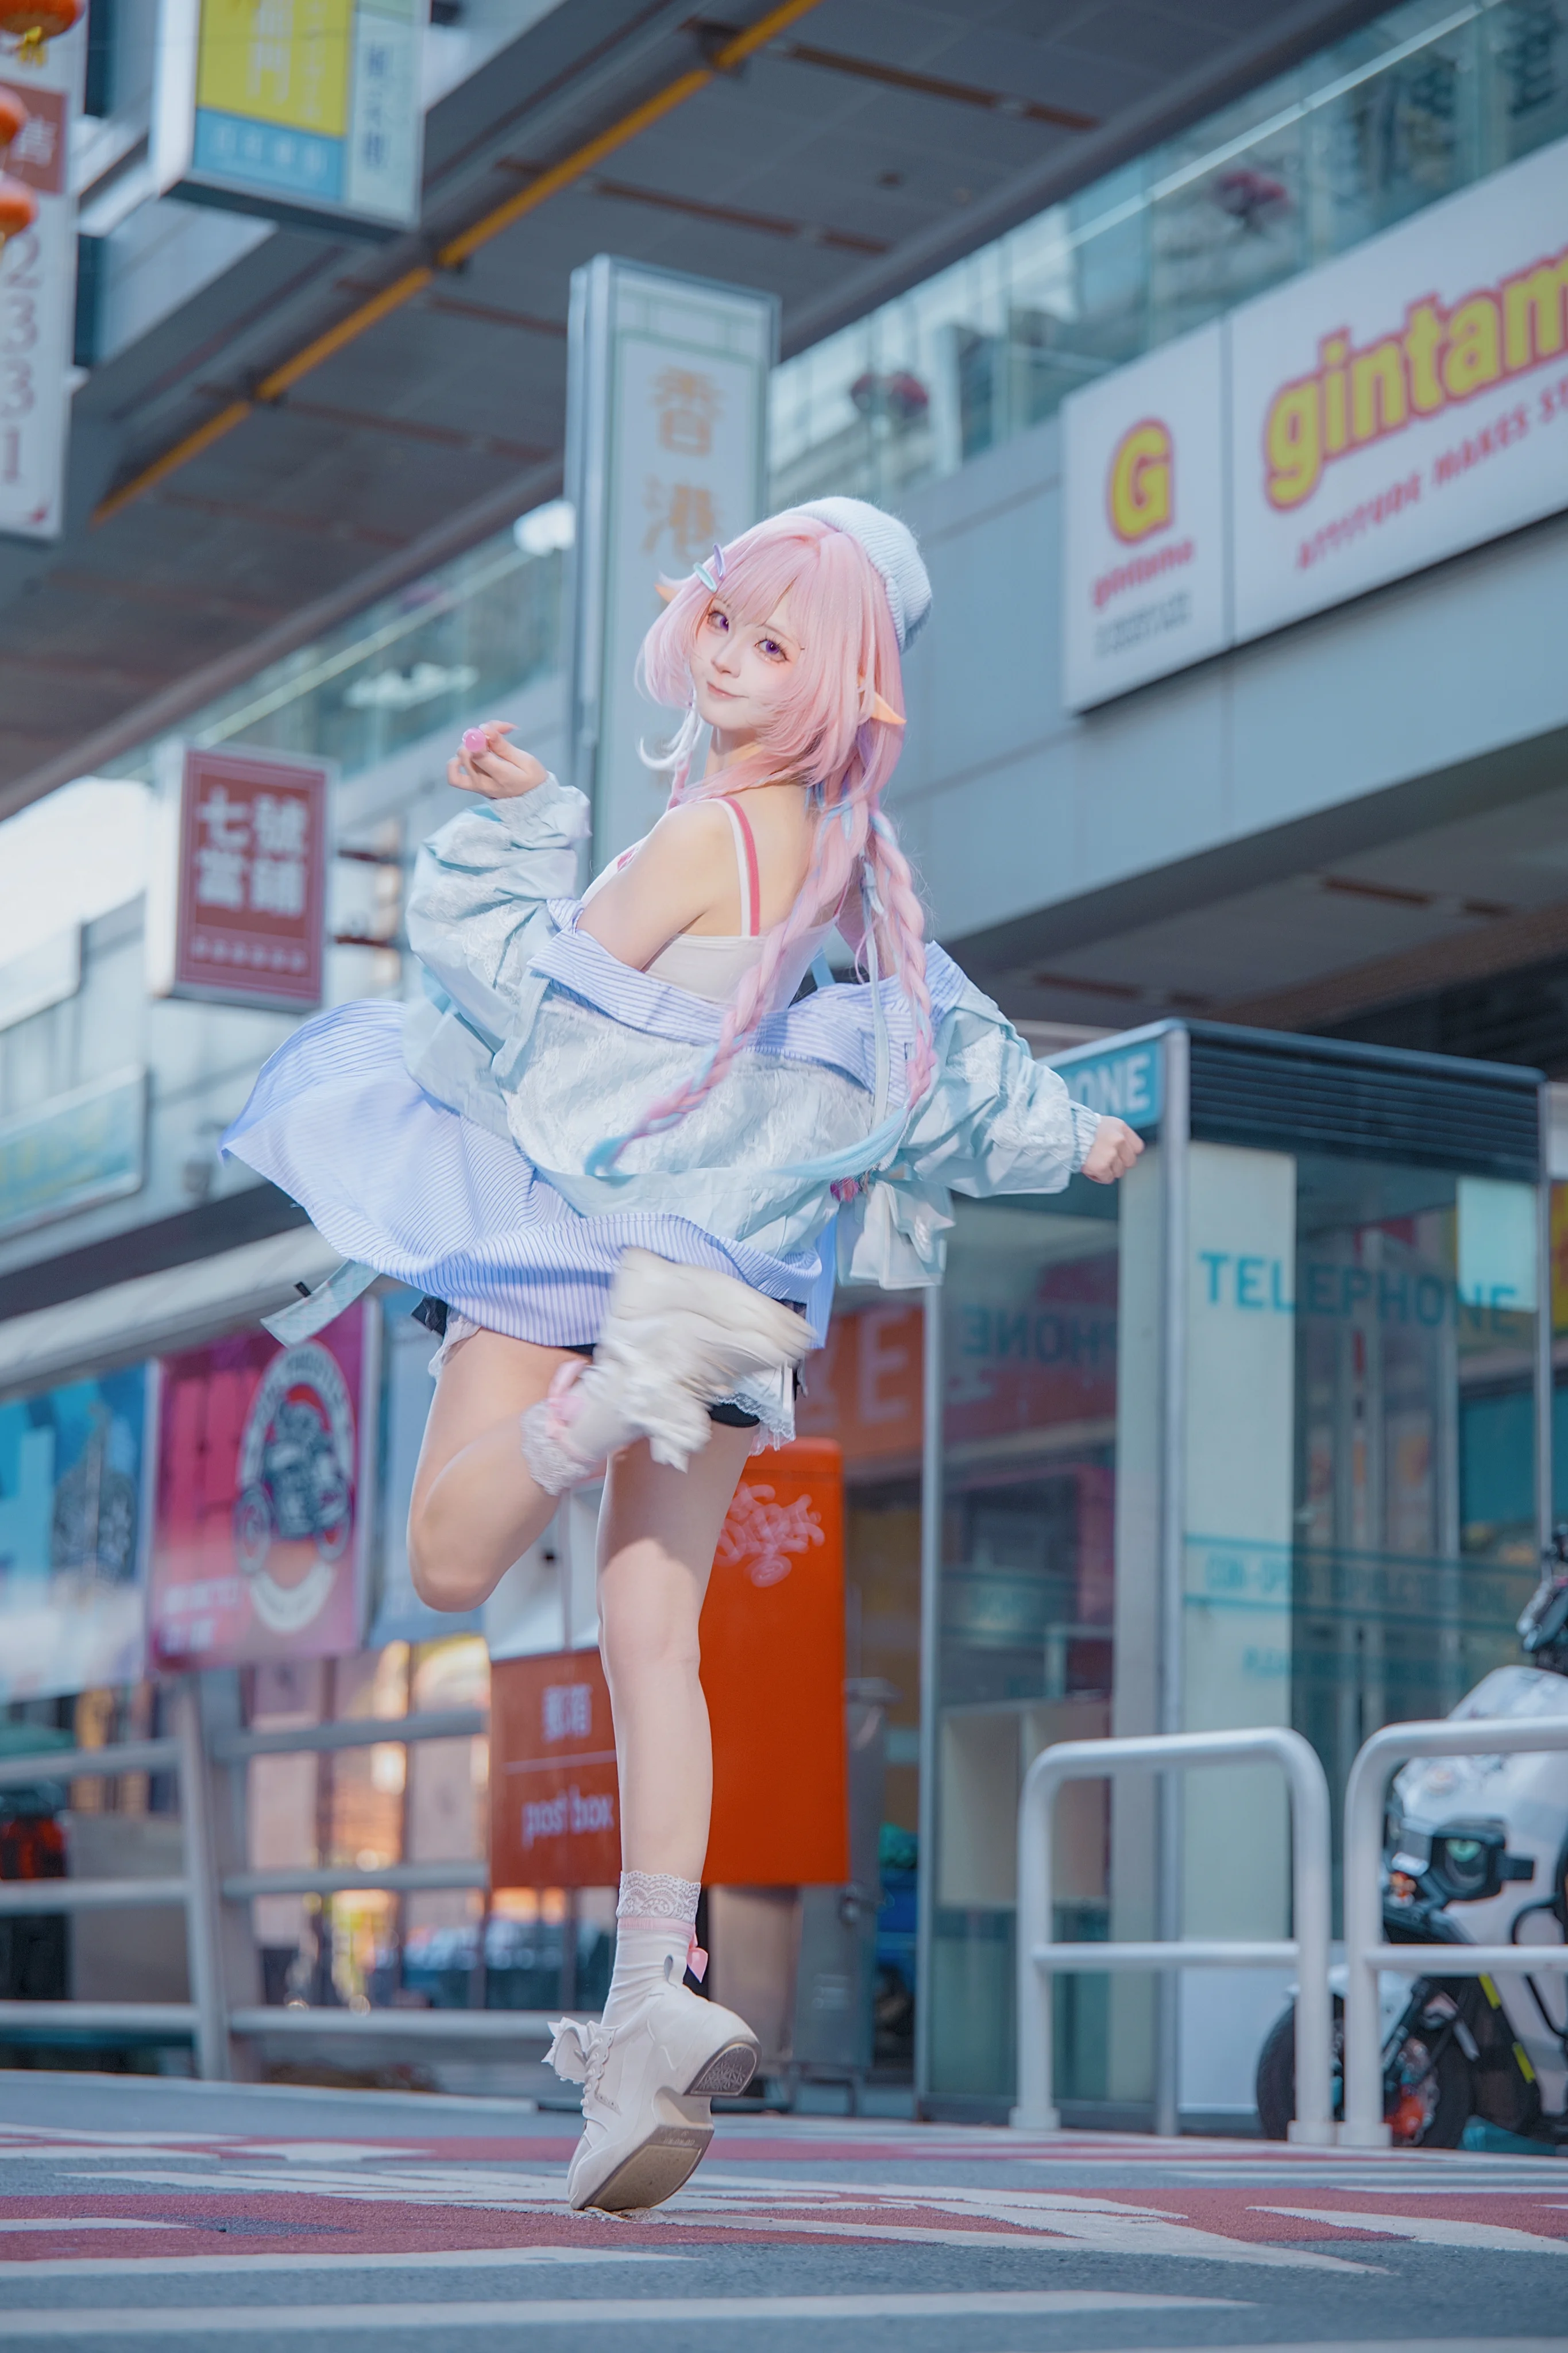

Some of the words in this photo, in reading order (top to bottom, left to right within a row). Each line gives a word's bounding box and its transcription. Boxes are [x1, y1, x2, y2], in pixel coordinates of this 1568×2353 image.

[1106, 418, 1175, 547] G
[1064, 1052, 1151, 1116] ONE
[1199, 1250, 1519, 1334] TELEPHONE
[523, 1789, 567, 1851] post
[570, 1784, 613, 1833] box
